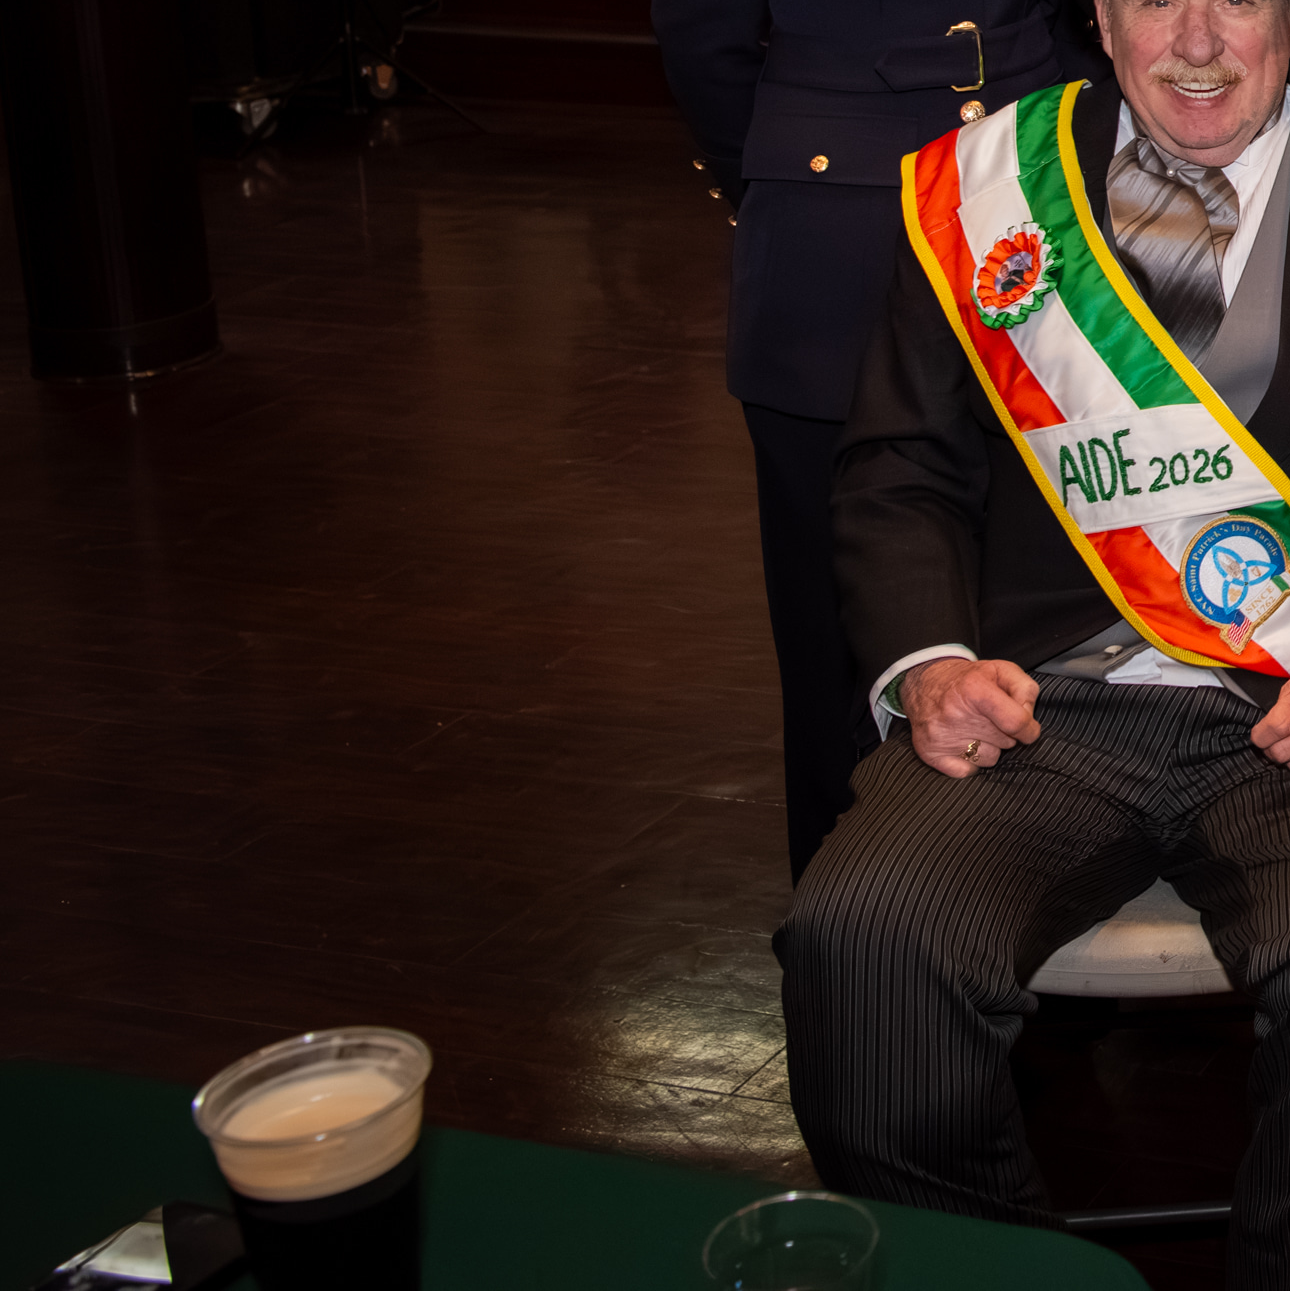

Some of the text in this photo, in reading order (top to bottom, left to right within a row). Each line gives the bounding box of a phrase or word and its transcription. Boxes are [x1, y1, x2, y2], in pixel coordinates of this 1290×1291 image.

[1058, 428, 1233, 506] AIDE 2026
[1194, 594, 1215, 615] NYC
[1231, 524, 1250, 534] Day
[1254, 529, 1278, 557] Parade
[1245, 585, 1275, 614] SINCE
[1256, 596, 1276, 616] 1762
